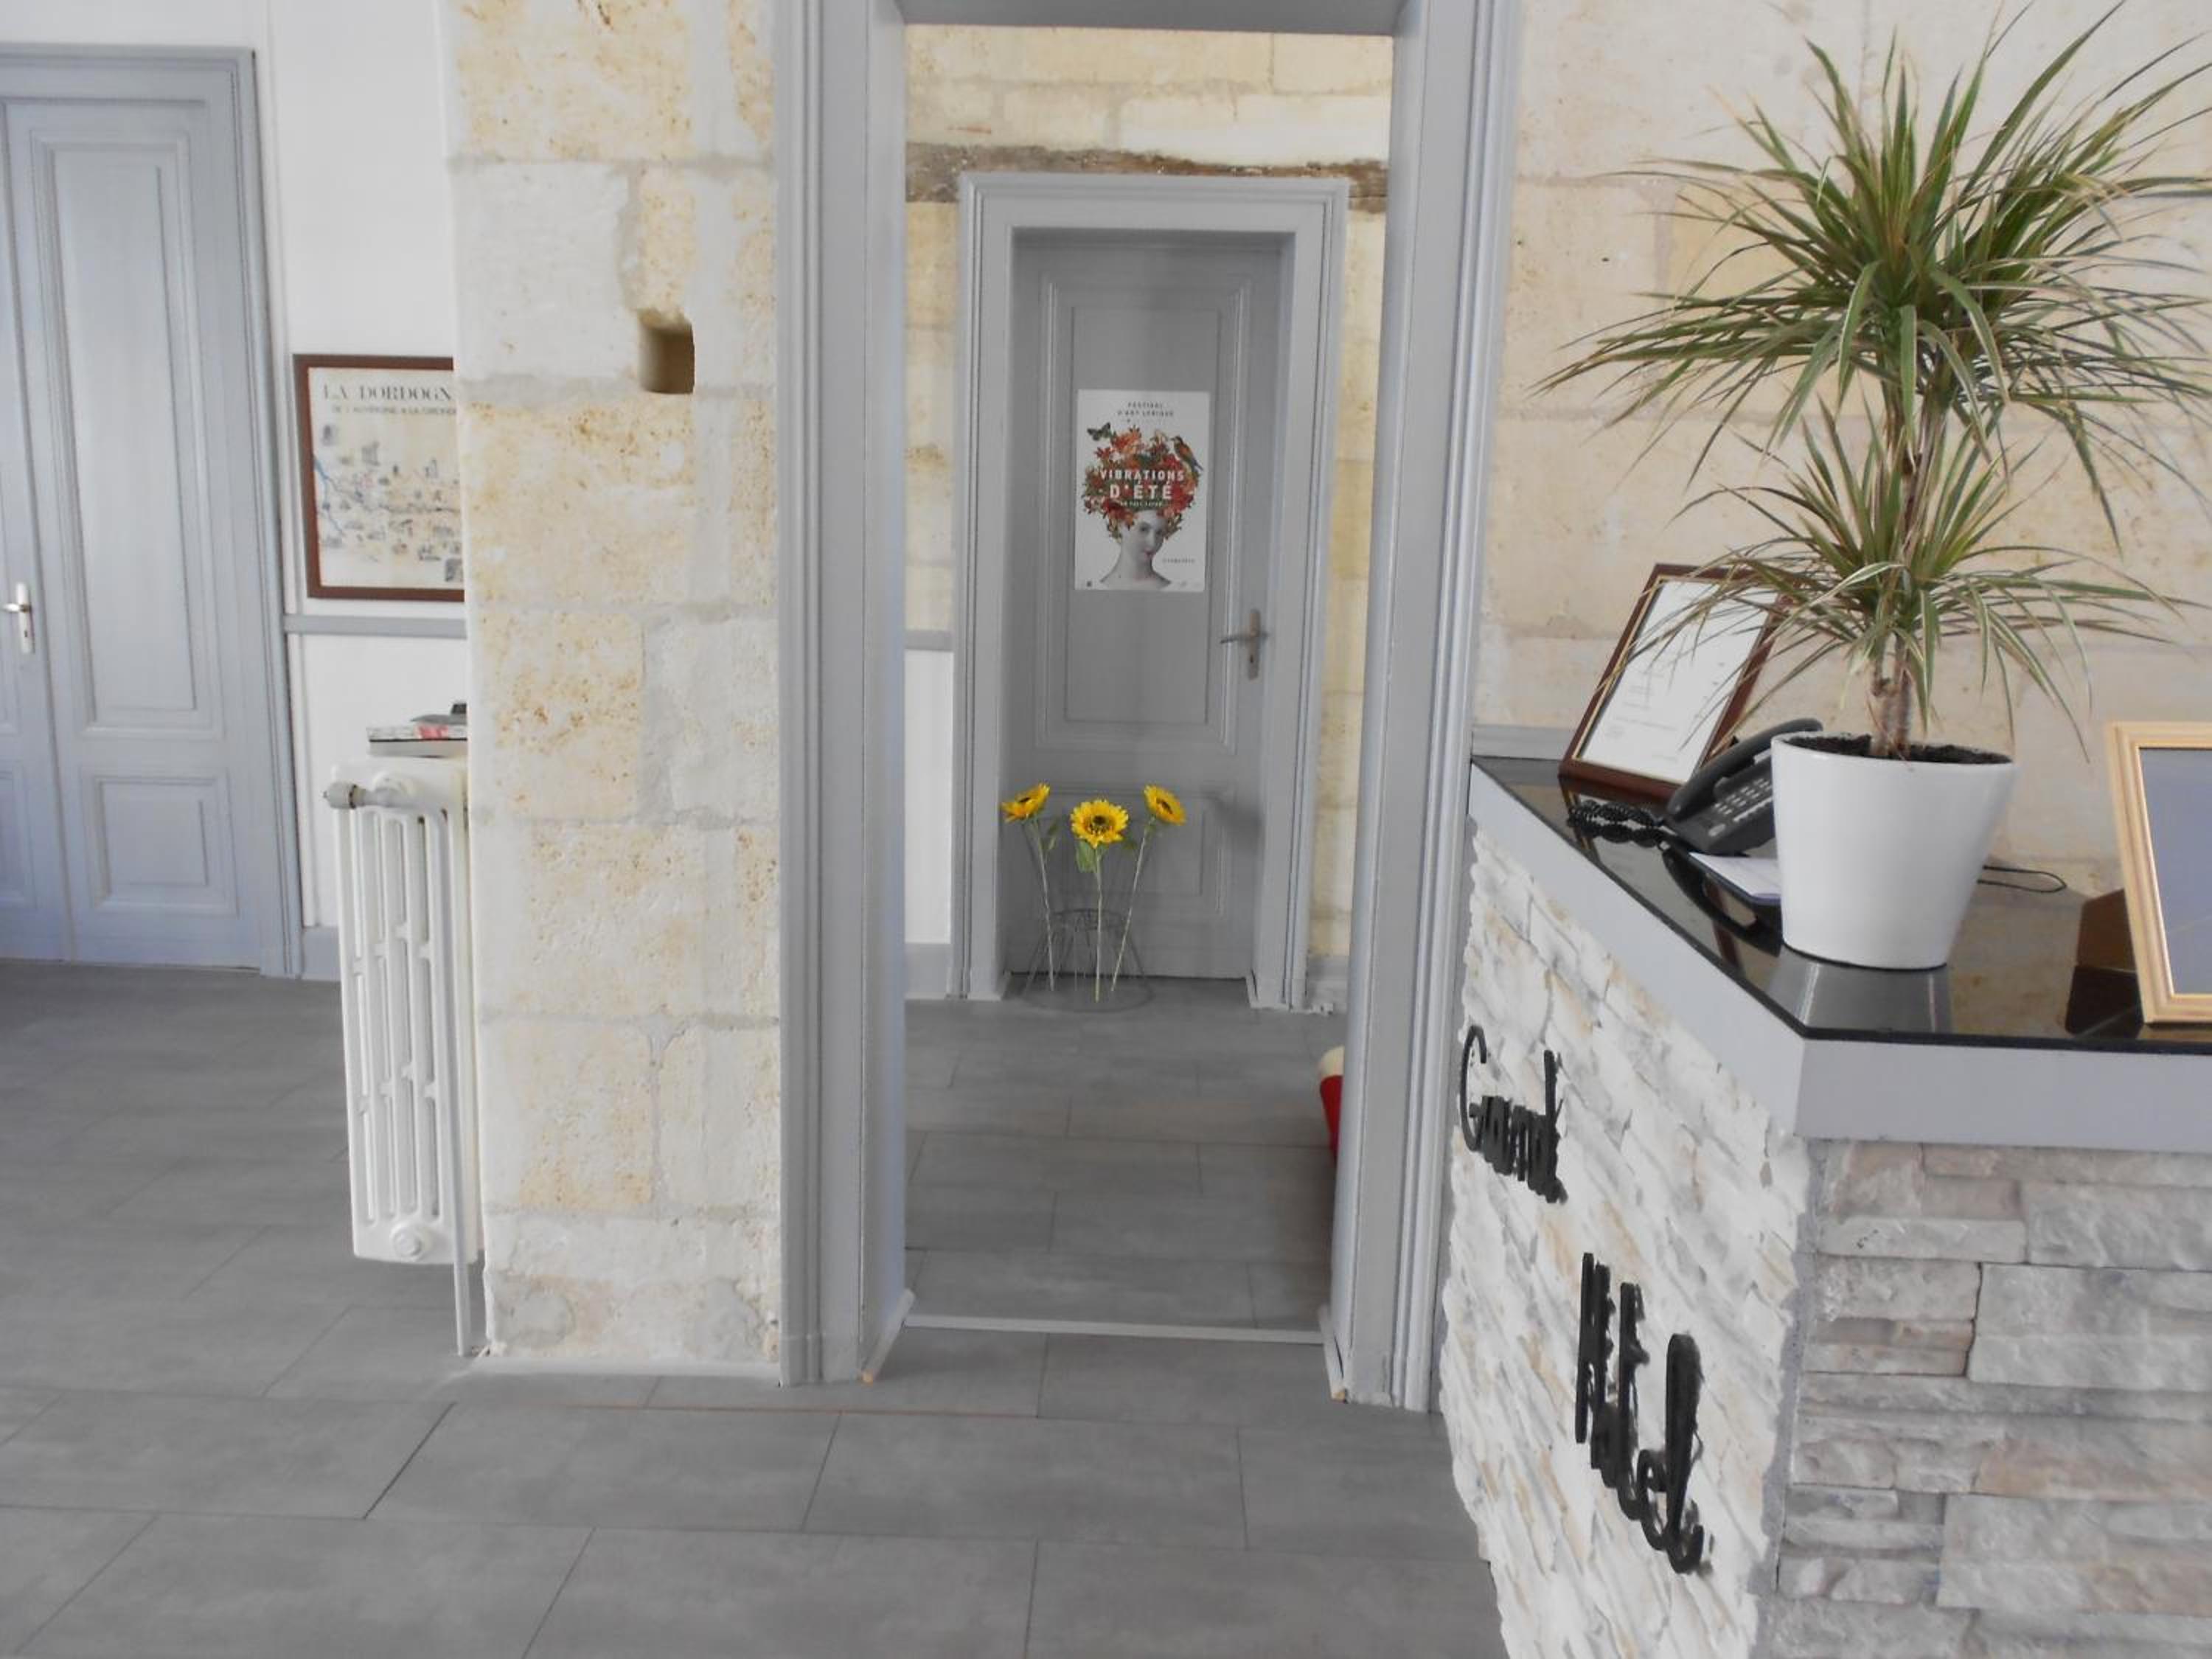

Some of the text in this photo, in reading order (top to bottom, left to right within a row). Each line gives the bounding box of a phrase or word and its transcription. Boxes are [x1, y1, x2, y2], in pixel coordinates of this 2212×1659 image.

[324, 383, 452, 400] LA DORDOGN
[1099, 469, 1185, 481] VIBRATIONS
[1109, 480, 1172, 499] D'ÉTÉ
[1459, 1025, 1568, 1203] Grand
